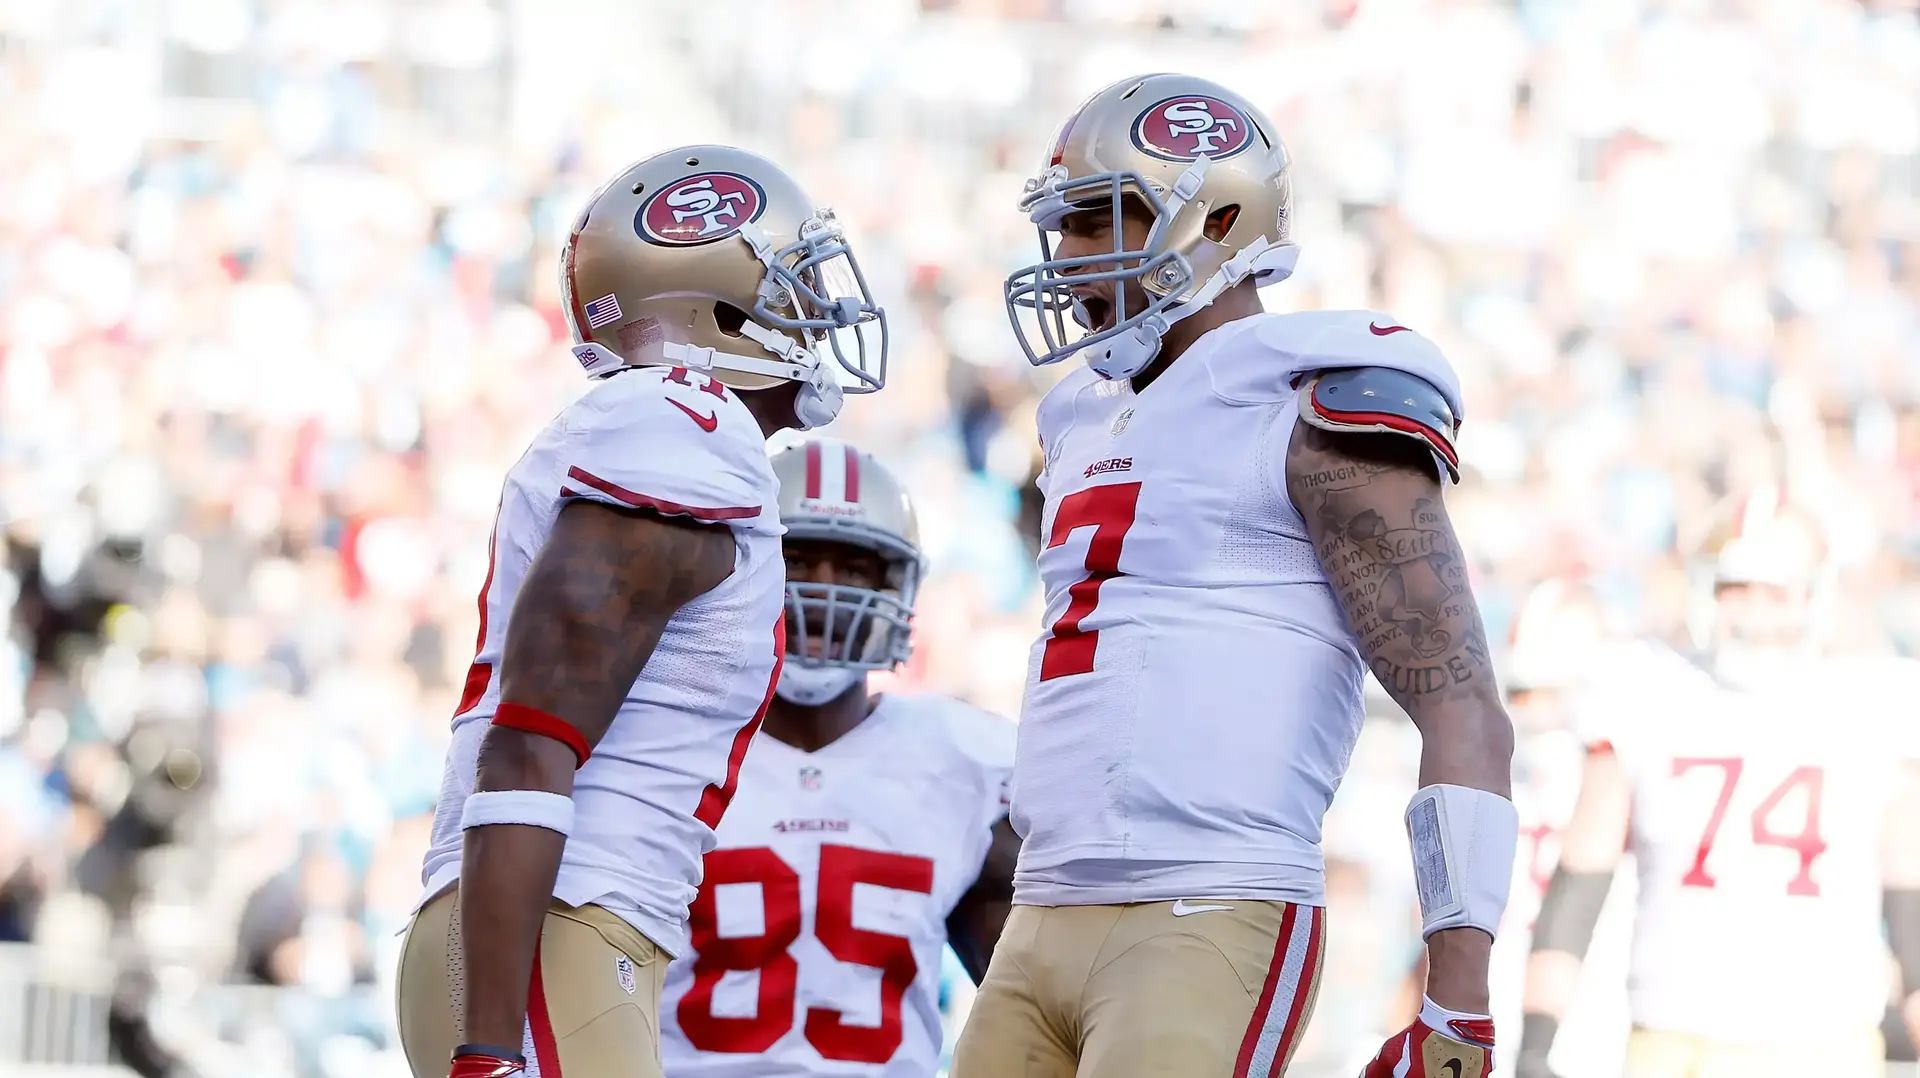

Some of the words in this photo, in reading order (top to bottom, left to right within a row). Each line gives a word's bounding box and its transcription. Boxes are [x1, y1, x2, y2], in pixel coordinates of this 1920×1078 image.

[1163, 101, 1236, 153] SF
[665, 179, 746, 236] SF
[1083, 457, 1134, 478] 49ERS
[1302, 466, 1357, 488] THOUGH
[1342, 549, 1364, 566] MY
[1349, 562, 1377, 581] NOT
[1040, 481, 1142, 682] 7
[1372, 655, 1472, 694] GUIDE
[1670, 757, 1828, 897] 74
[676, 842, 935, 1064] 85
